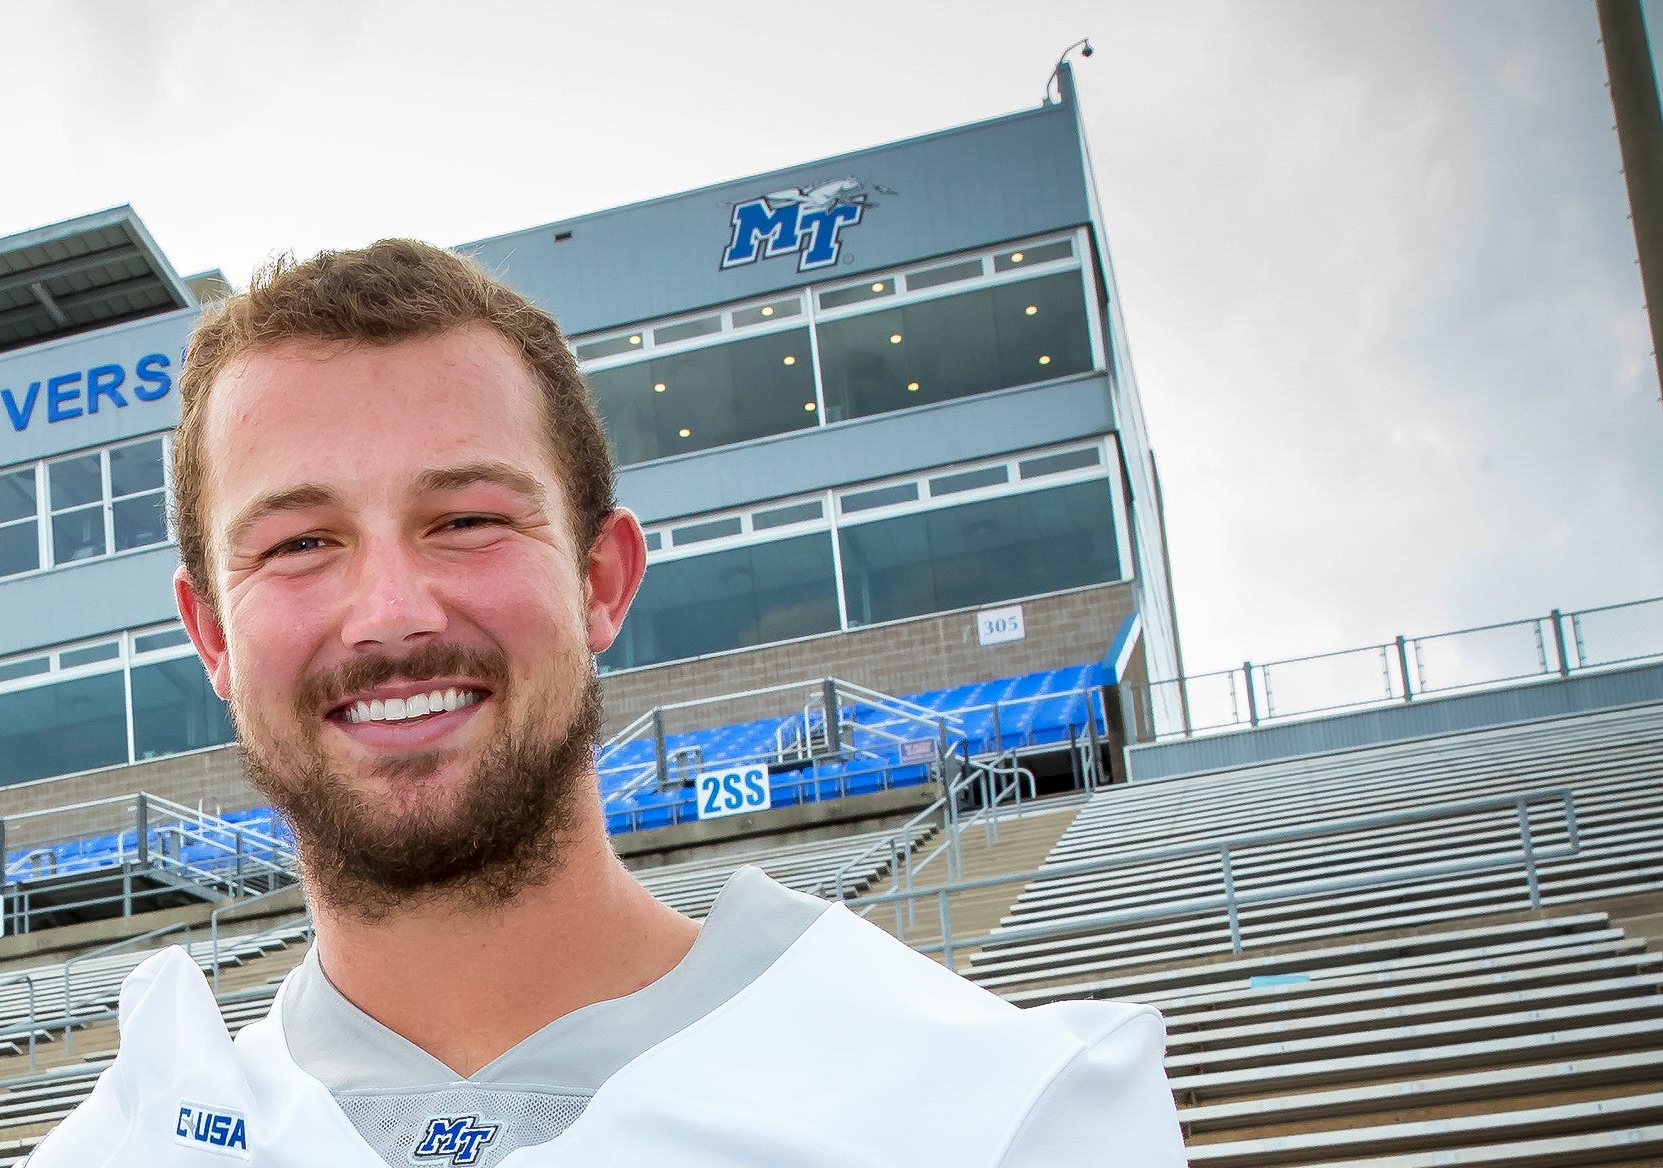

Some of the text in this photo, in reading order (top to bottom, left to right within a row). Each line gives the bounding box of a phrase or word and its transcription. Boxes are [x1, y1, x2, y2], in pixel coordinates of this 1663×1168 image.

[720, 196, 866, 273] MT
[984, 615, 1018, 635] 305
[702, 769, 765, 814] 2SS
[414, 1116, 499, 1165] MT
